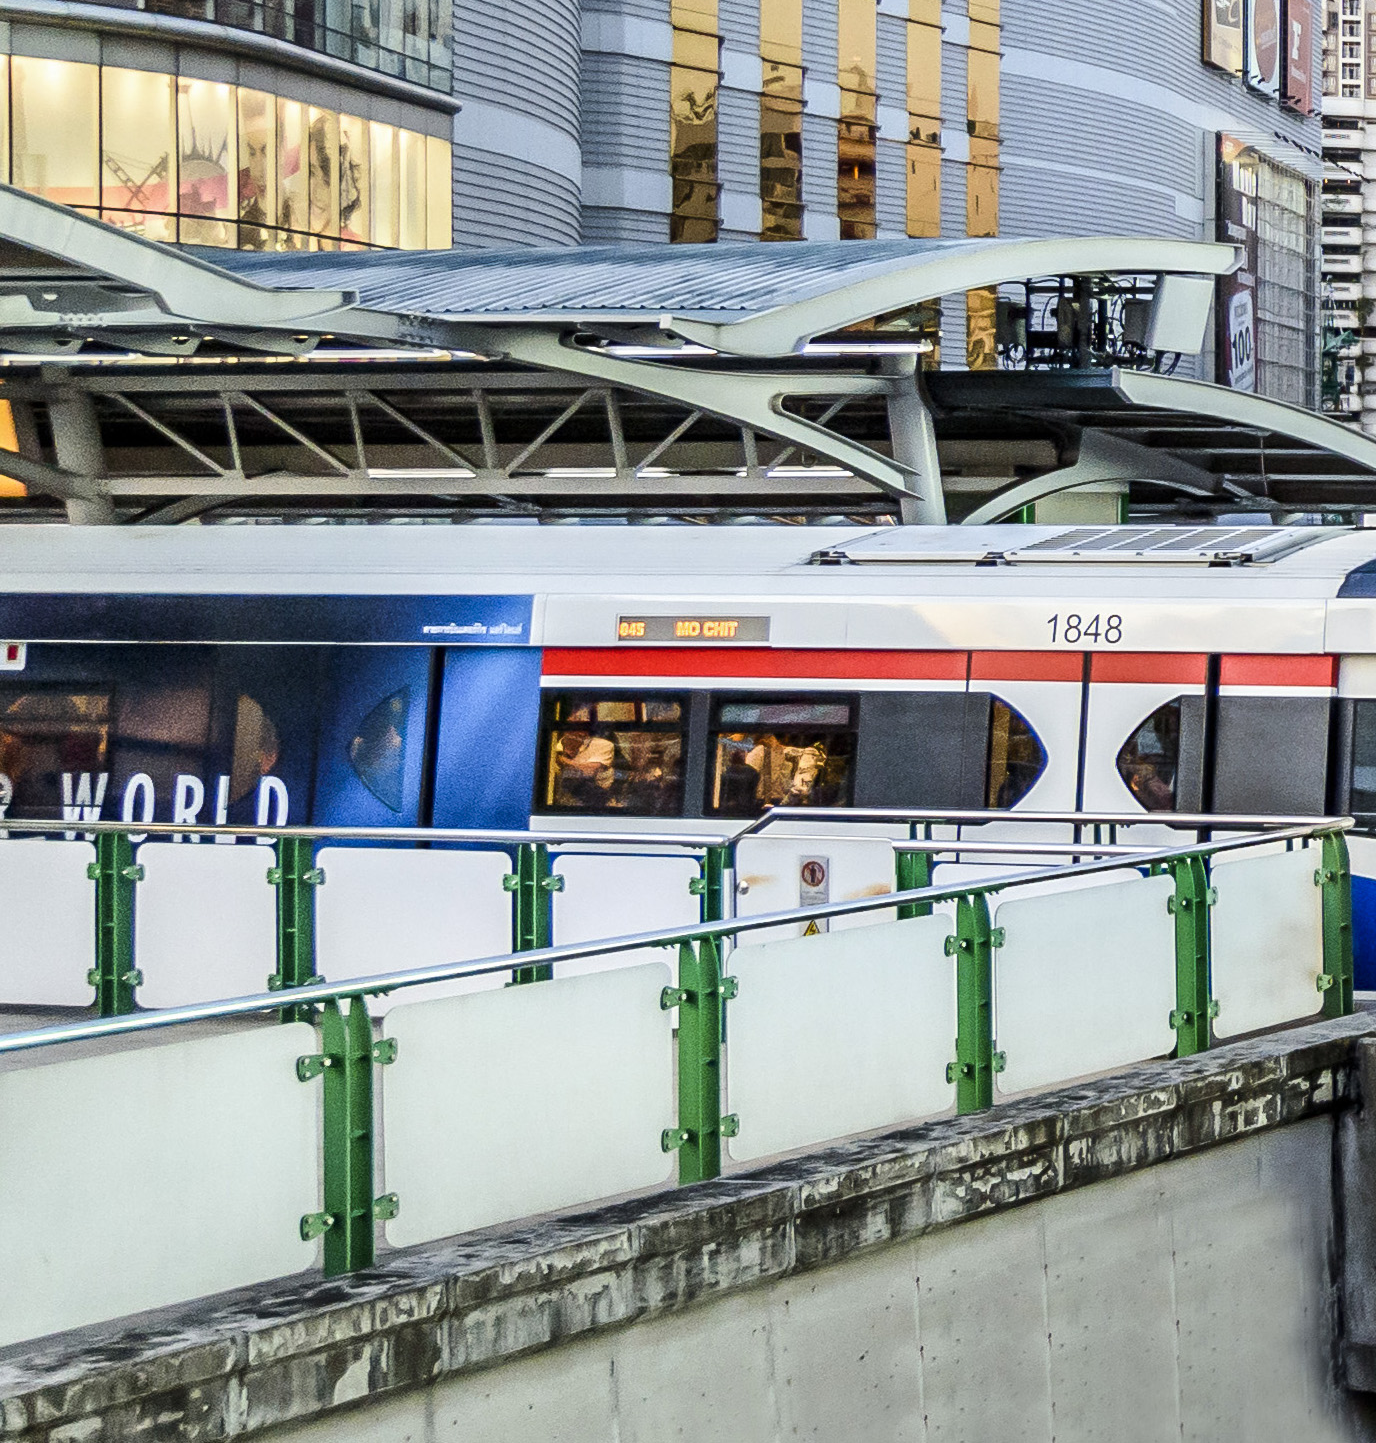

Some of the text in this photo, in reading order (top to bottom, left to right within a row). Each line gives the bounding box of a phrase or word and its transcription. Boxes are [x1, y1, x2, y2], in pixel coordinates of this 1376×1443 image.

[675, 621, 739, 638] MO CHIT
[1046, 614, 1124, 644] 1848
[61, 772, 290, 844] WORLD
